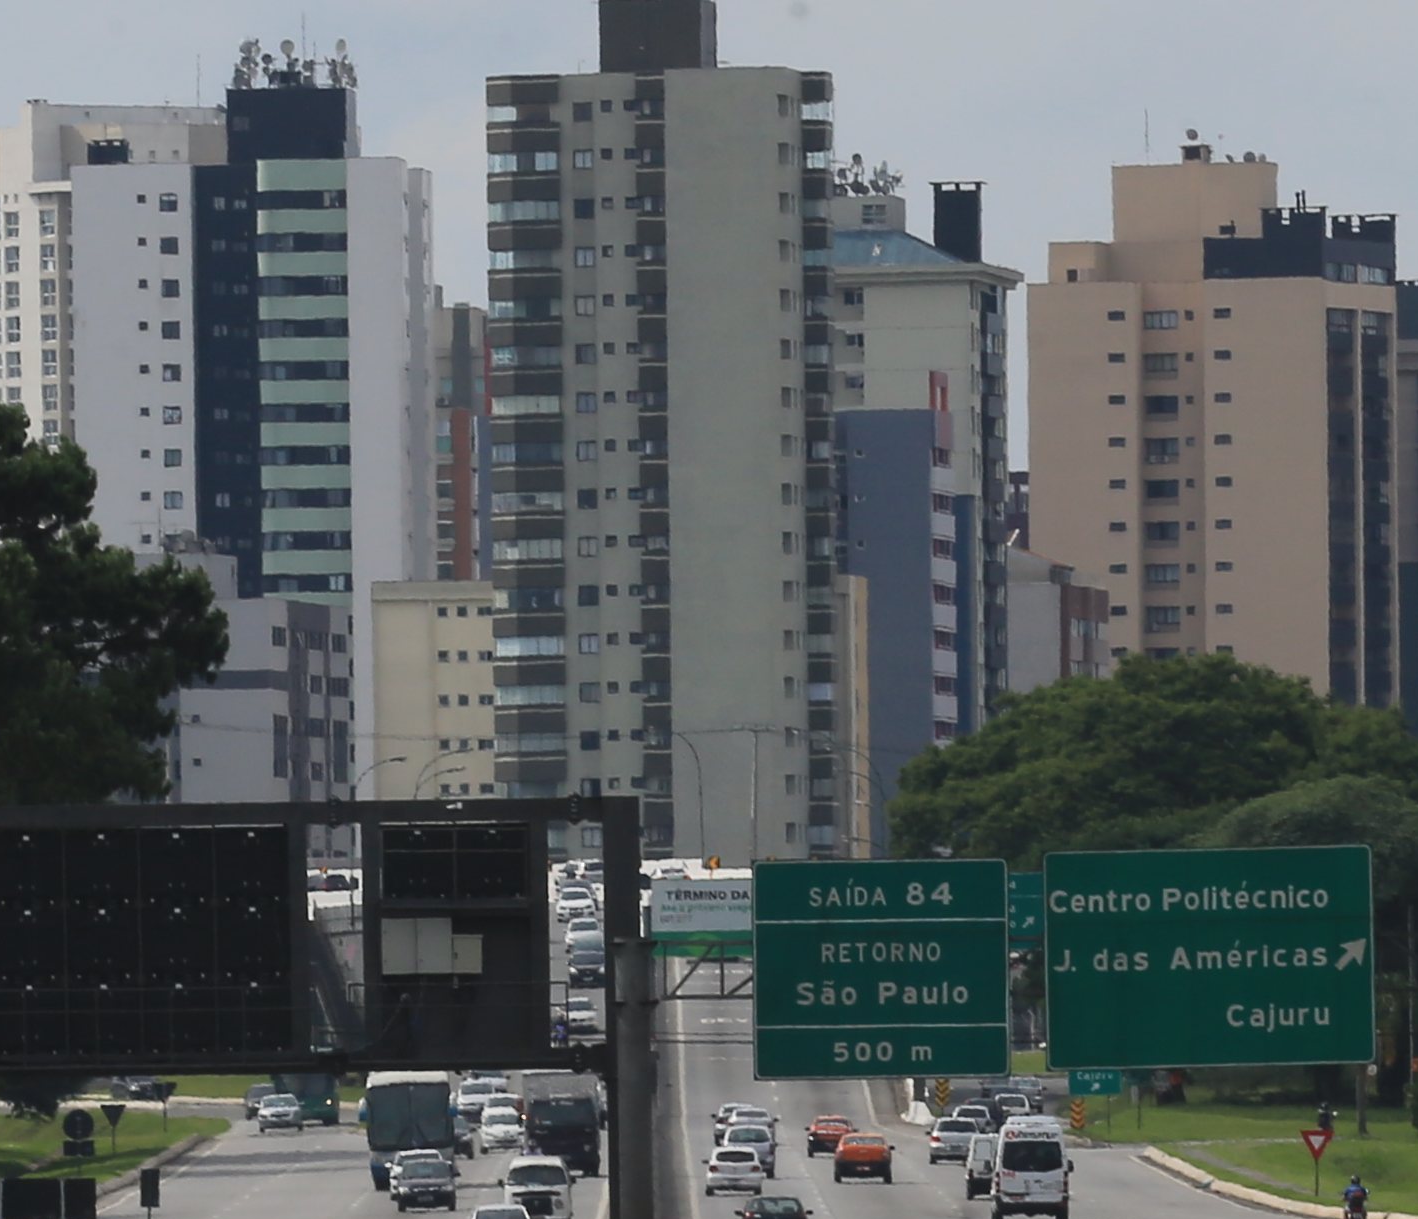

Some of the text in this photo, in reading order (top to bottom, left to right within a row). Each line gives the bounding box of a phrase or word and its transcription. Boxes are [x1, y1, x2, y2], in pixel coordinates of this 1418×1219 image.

[809, 879, 954, 907] SAÍDA 84
[1049, 880, 1329, 914] Centro Politécnico
[821, 942, 941, 964] RETORNO
[1053, 940, 1328, 972] J. das Américas
[796, 980, 969, 1005] São Paulo
[1226, 1004, 1330, 1032] Cajuru
[834, 1041, 932, 1062] 500 m
